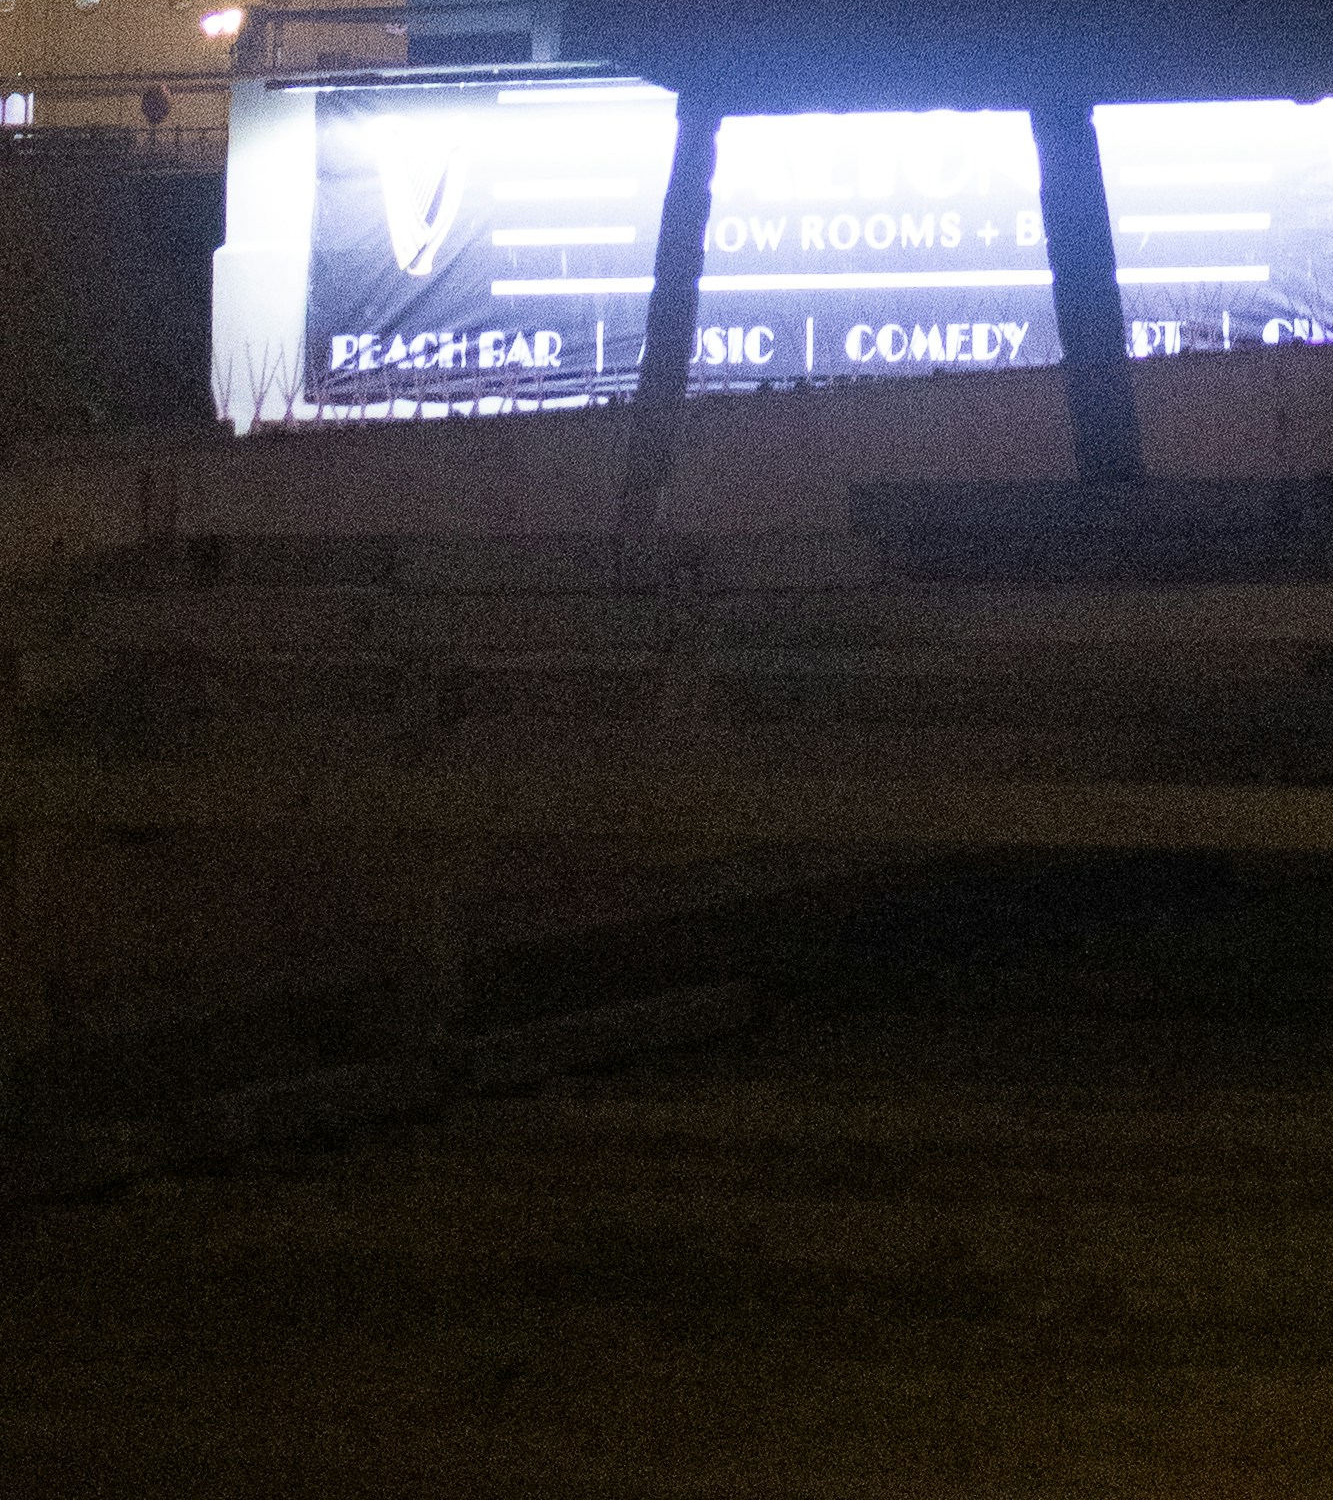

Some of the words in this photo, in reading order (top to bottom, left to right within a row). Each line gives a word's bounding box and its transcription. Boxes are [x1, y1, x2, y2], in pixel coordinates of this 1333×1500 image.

[703, 215, 786, 252] OW
[800, 211, 962, 251] ROOMS
[478, 329, 562, 368] BAR
[845, 321, 1029, 363] COMEDY
